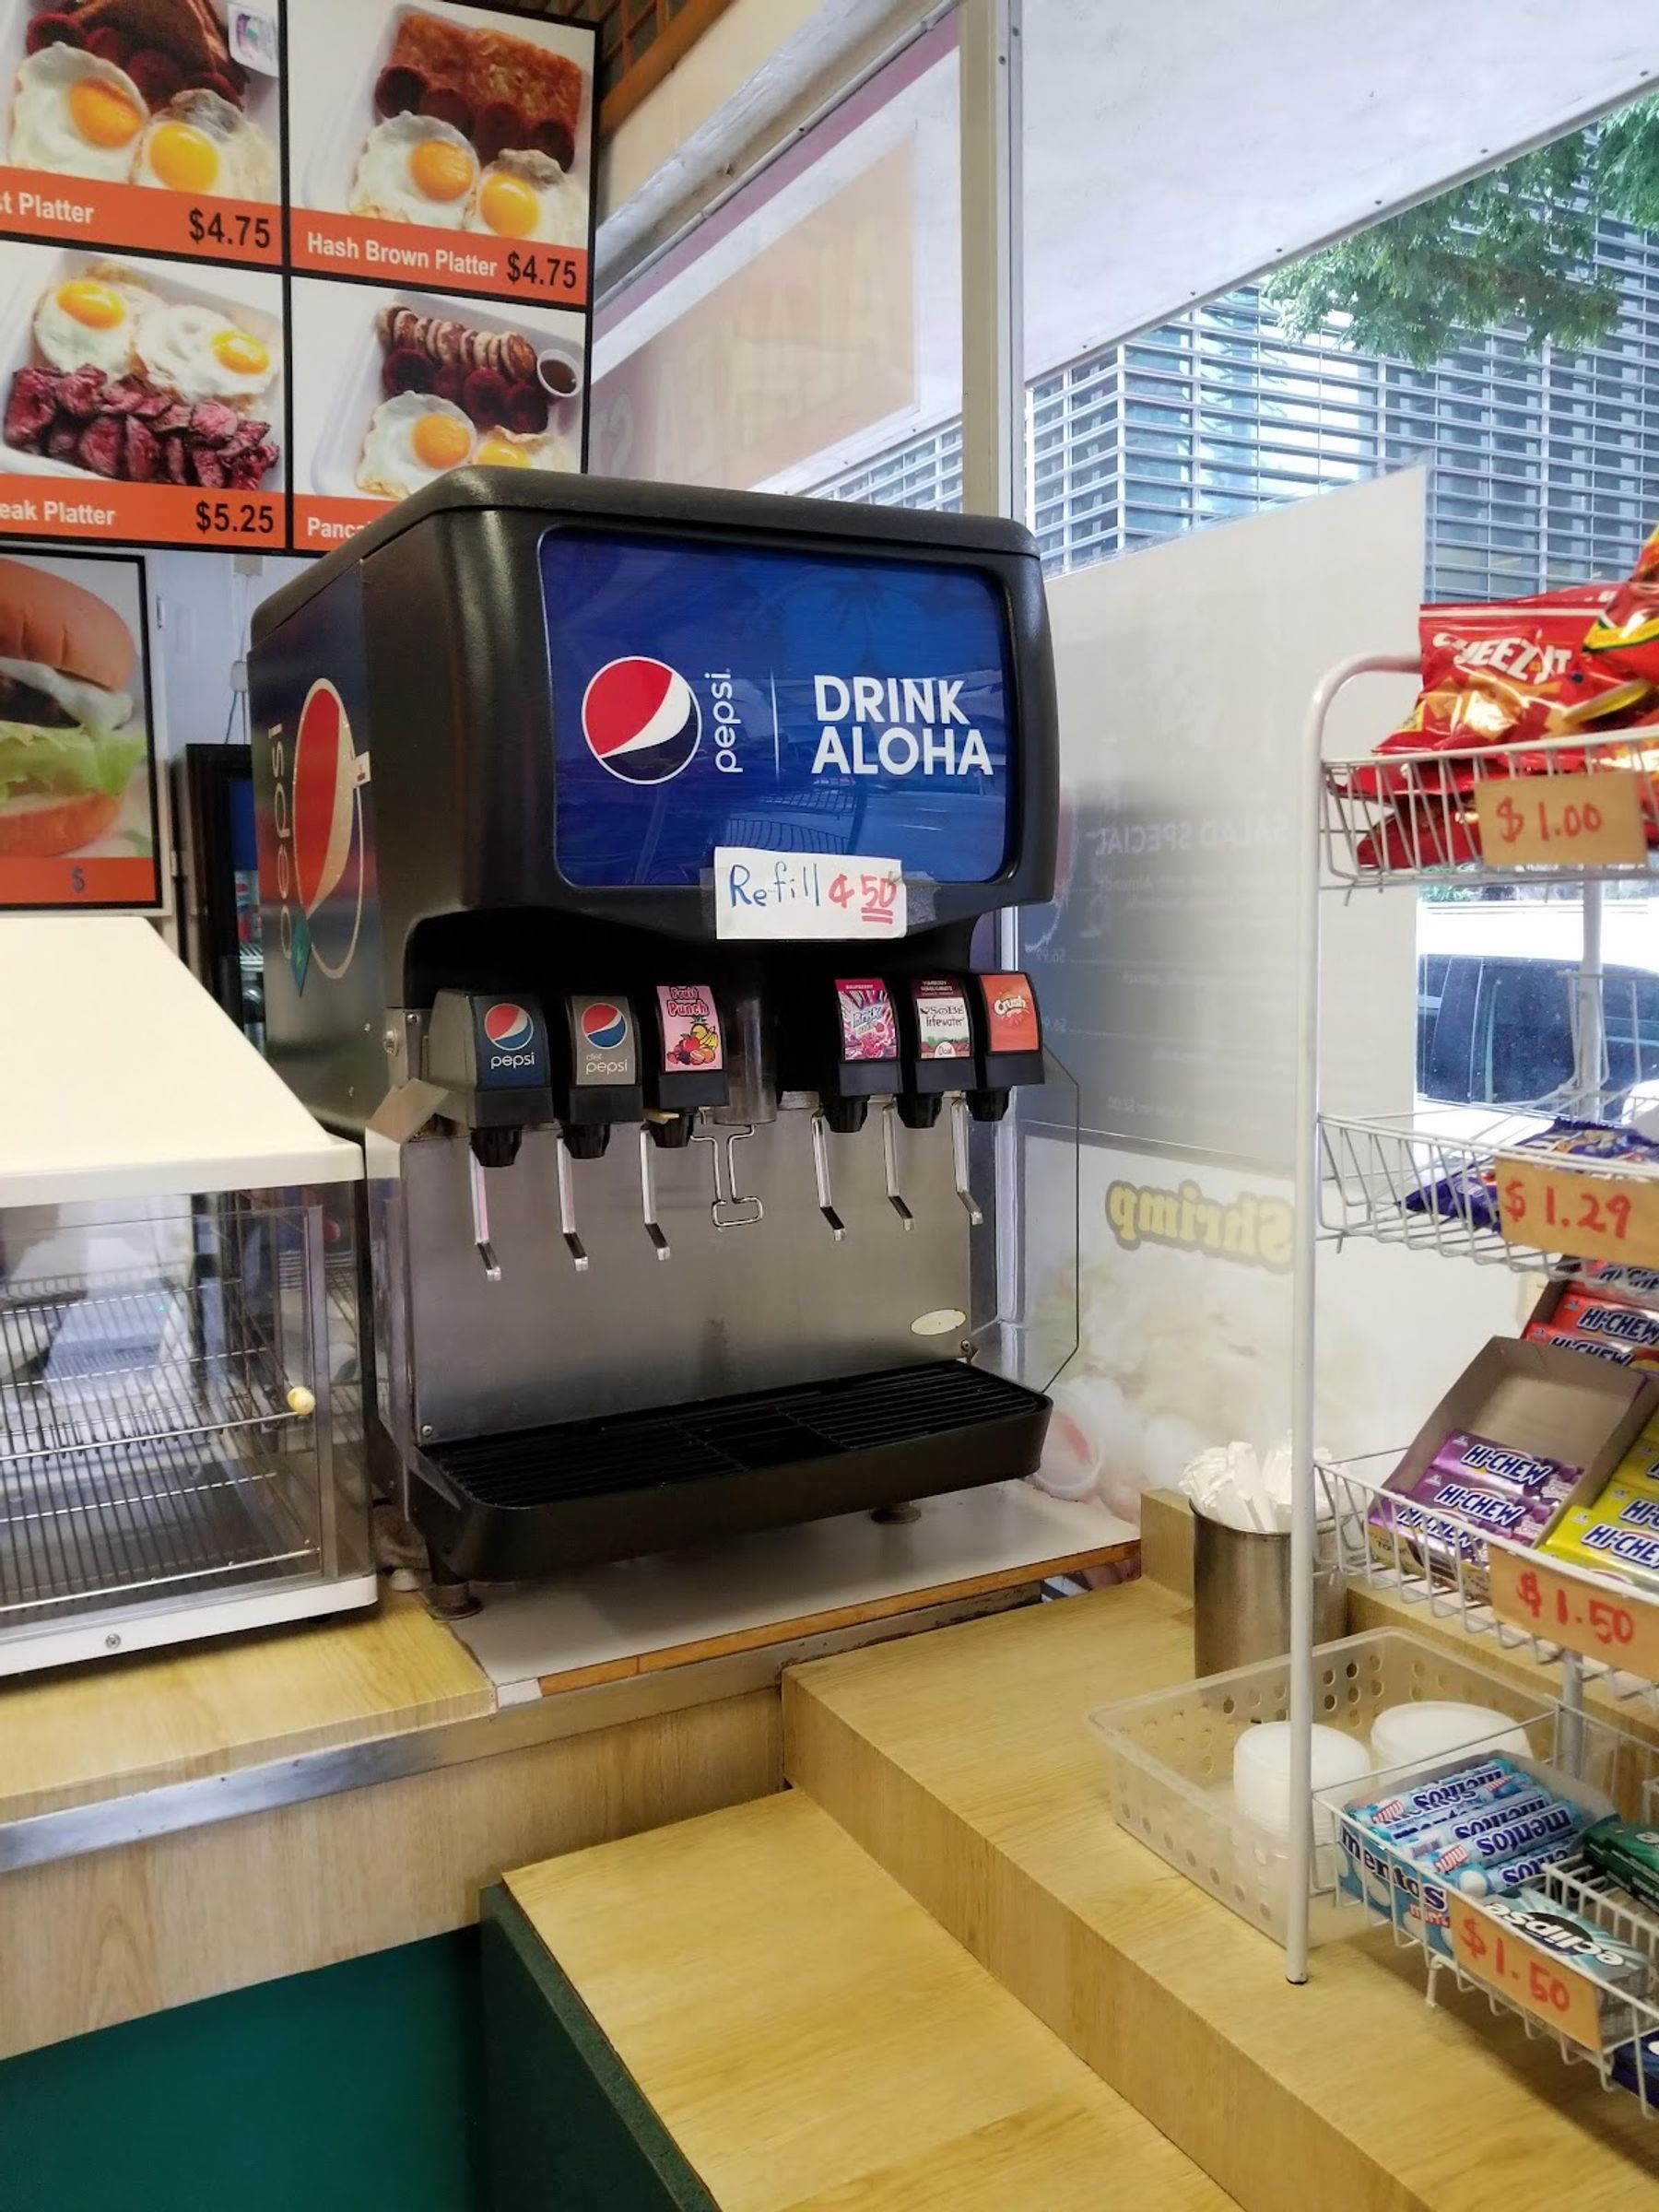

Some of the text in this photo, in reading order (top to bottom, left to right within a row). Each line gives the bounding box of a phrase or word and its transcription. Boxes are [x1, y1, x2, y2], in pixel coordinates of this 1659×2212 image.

[18, 191, 95, 224] Platter
[188, 207, 271, 249] $4.75
[307, 231, 578, 289] Hash Brown Platter $4.75
[44, 500, 116, 526] Platter
[196, 500, 275, 535] $5.25
[704, 668, 743, 773] pepsi
[813, 675, 971, 725] DRINK
[811, 724, 994, 776] ALOHA
[729, 860, 820, 908] Refill
[666, 999, 709, 1017] Punch
[490, 1052, 535, 1070] pepsi
[585, 1058, 629, 1076] pepsi
[1461, 1443, 1552, 1487] HI-CHEW
[1434, 1483, 1526, 1526] HI-CHEW
[1475, 1807, 1571, 1857] mentos
[1483, 1901, 1625, 1967] eclipse
